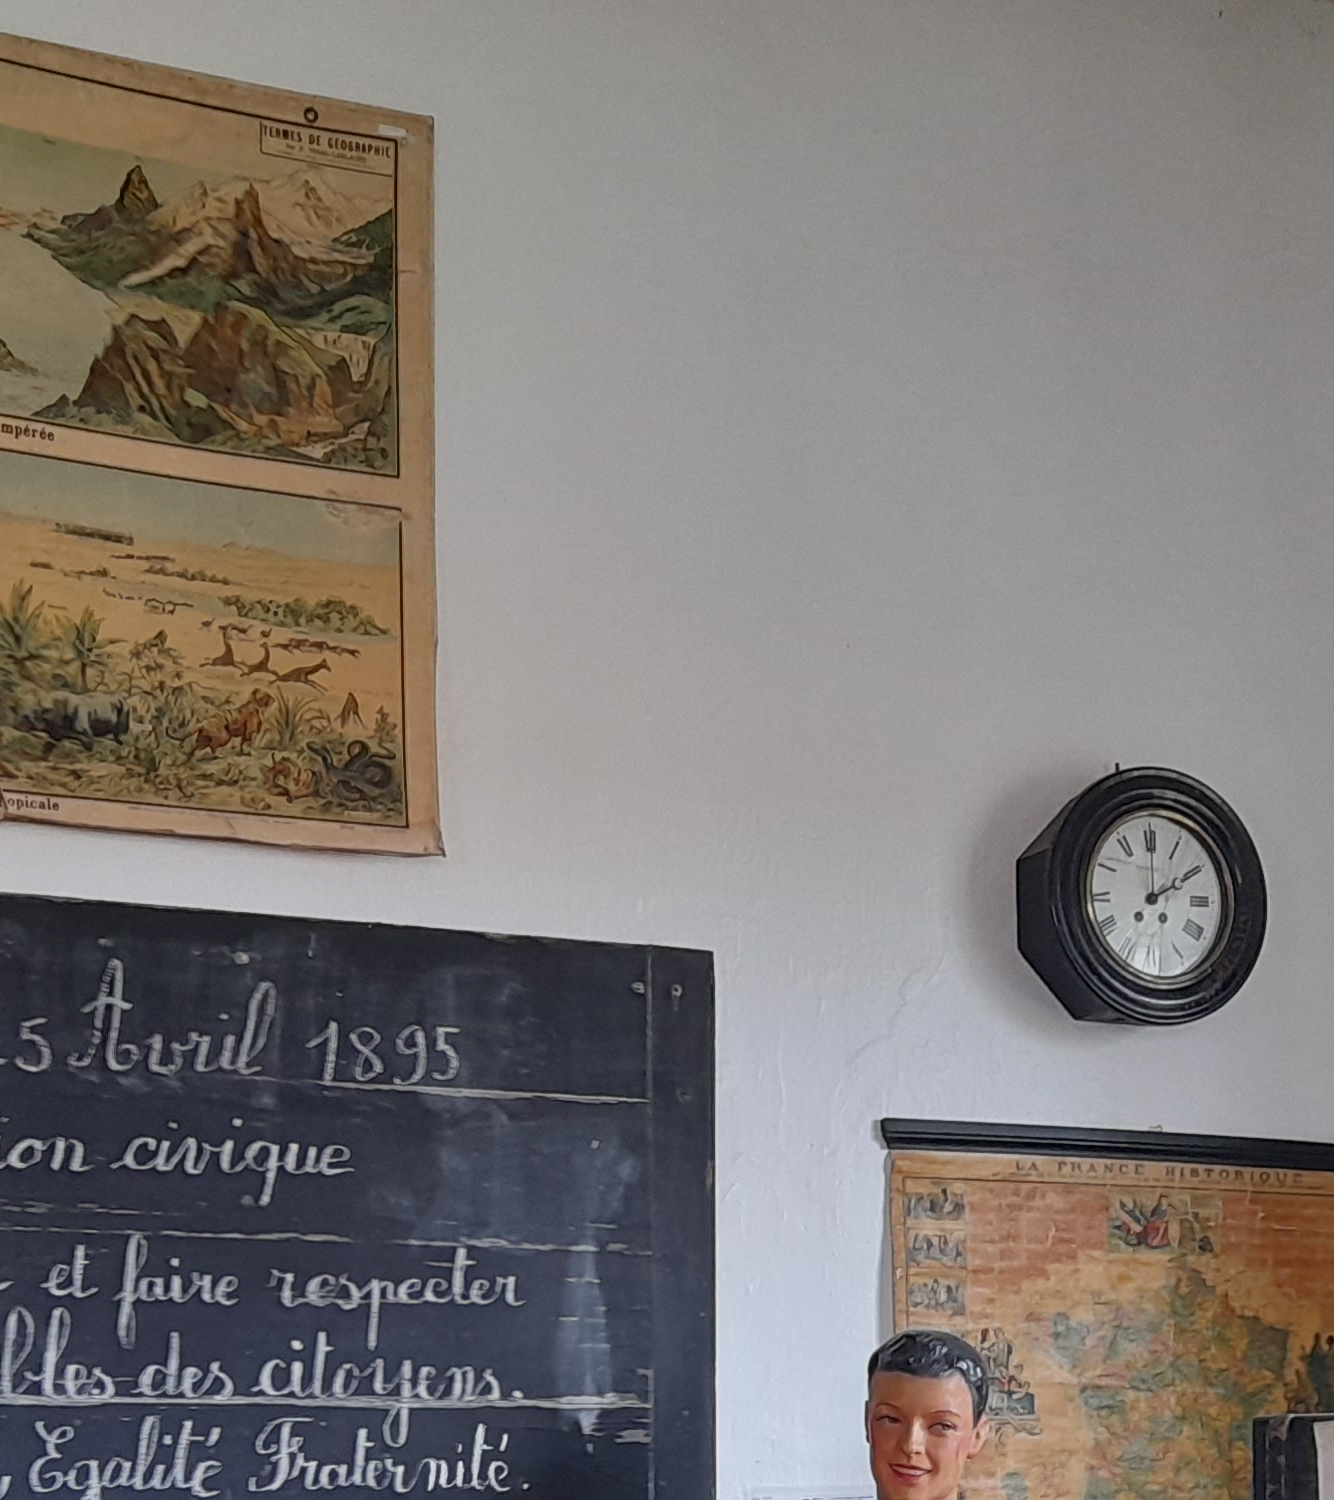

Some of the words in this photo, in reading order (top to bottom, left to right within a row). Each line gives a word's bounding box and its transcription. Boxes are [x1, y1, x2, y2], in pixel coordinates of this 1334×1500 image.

[308, 134, 322, 147] DE
[67, 956, 279, 1077] Avril
[305, 1018, 464, 1087] 1895
[109, 1117, 355, 1208] civique
[1015, 1161, 1039, 1172] LA
[1058, 1162, 1146, 1176] FRANCE
[1166, 1166, 1305, 1185] HISTORIQUE
[38, 1244, 100, 1299] et
[115, 1233, 241, 1350] faire
[268, 1245, 527, 1351] respecter
[132, 1331, 235, 1400] des
